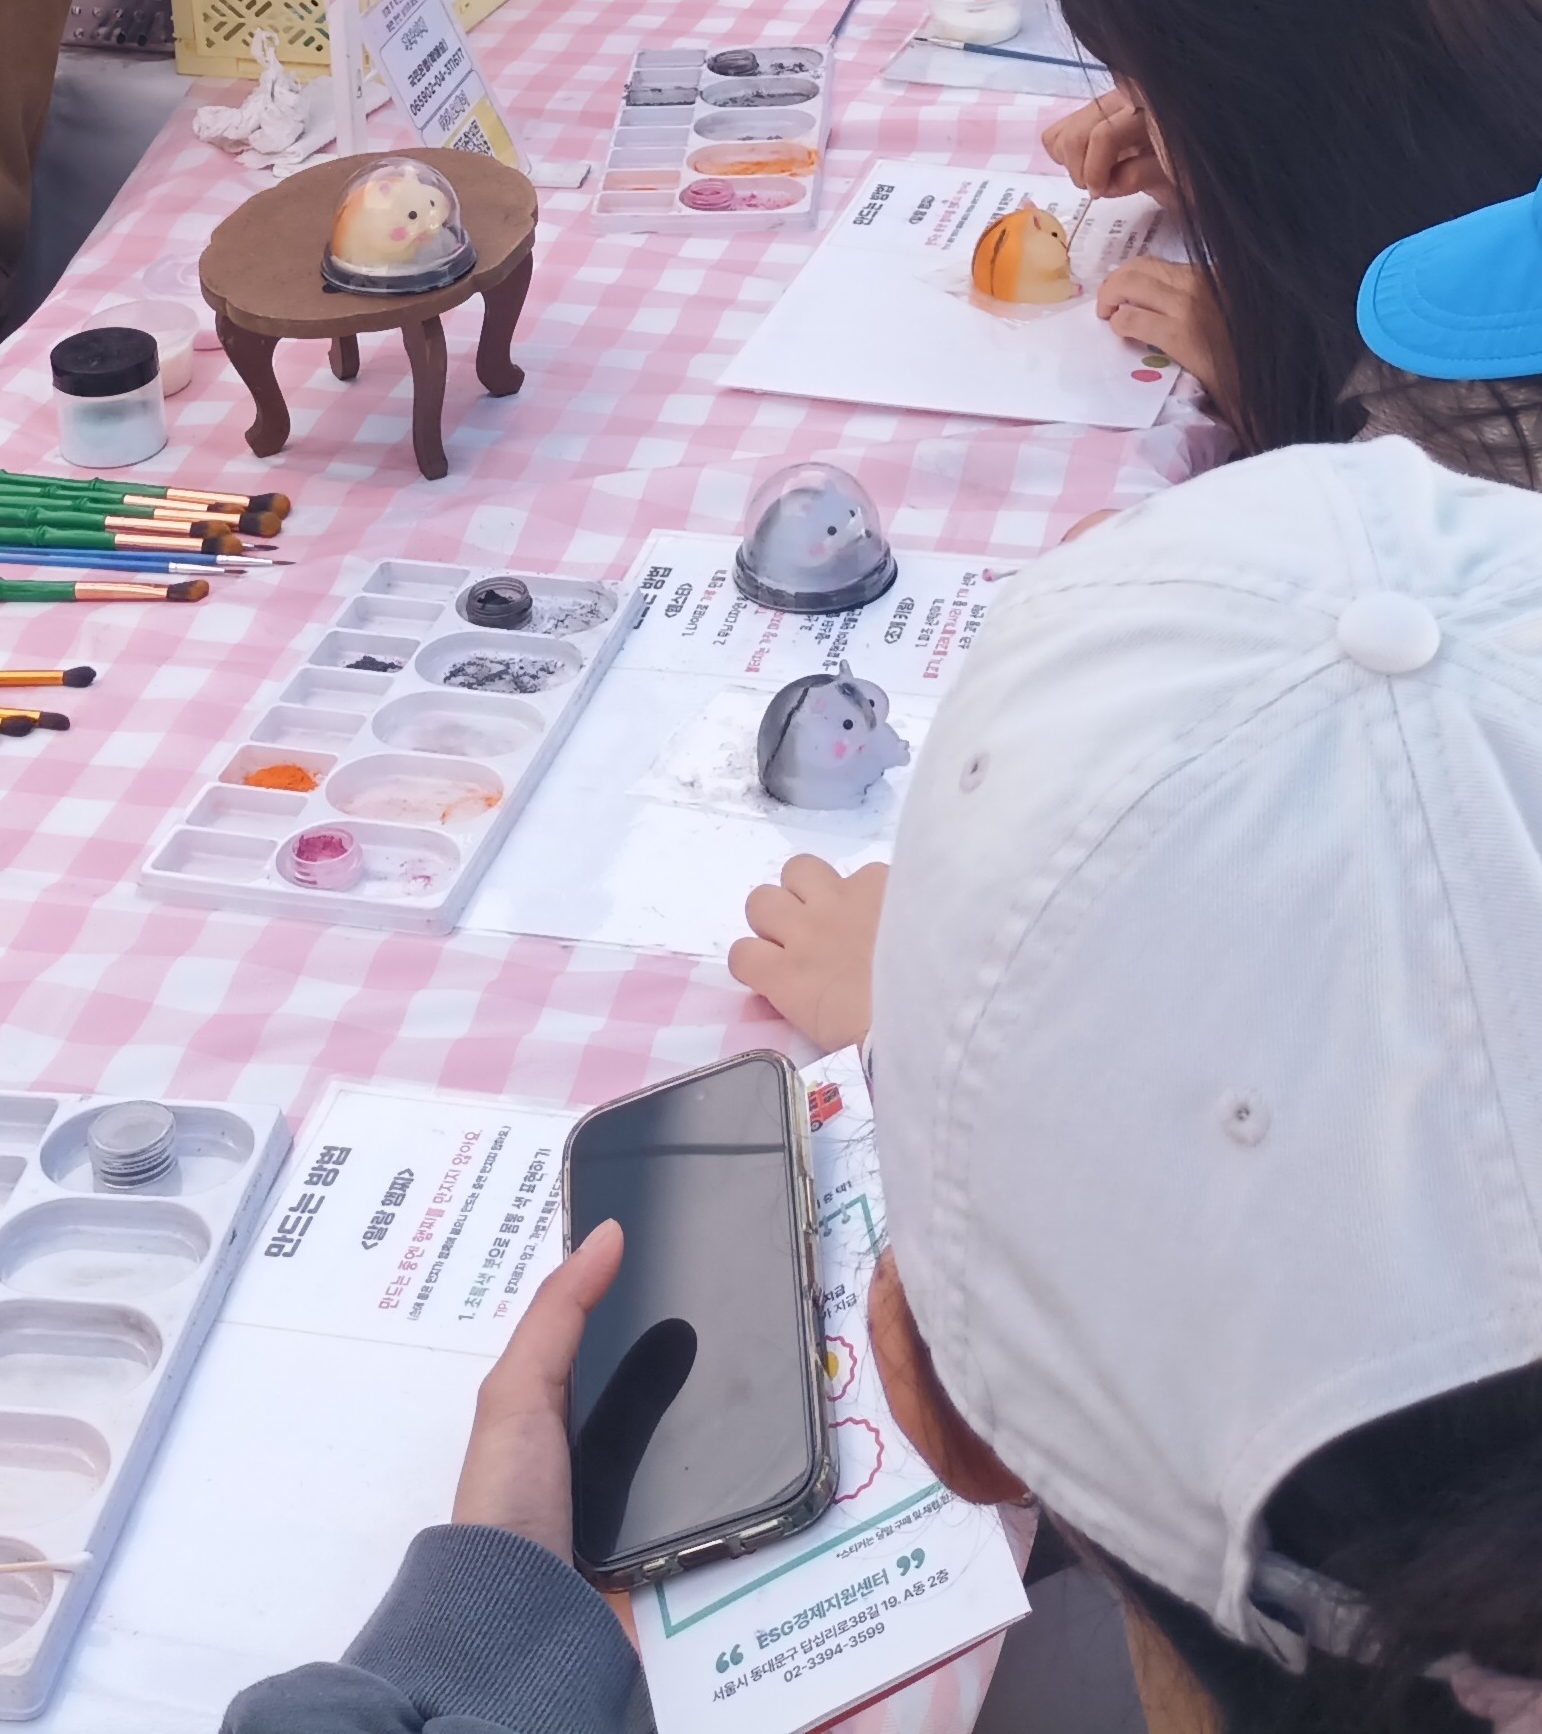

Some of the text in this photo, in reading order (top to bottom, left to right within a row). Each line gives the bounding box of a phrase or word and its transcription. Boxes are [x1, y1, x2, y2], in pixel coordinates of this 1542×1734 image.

[638, 565, 673, 589] 방법
[263, 1144, 352, 1257] 만드는 방법
[357, 1209, 396, 1248] <말랑
[377, 1130, 482, 1308] 만드는 중엔 햄찌를 만지지 않아요.
[457, 1148, 551, 1320] 1. 초록색 붓으로 몸통 색 표현하기
[835, 1293, 858, 1313] 지급
[712, 1674, 749, 1703] 서울시
[750, 1646, 799, 1684] 동대문구
[800, 1603, 881, 1656] 답십리로38길
[903, 1578, 926, 1602] A동
[927, 1568, 950, 1589] 2층
[756, 1568, 891, 1651] ESG경제지원센터
[782, 1622, 887, 1684] 02-3394-3599
